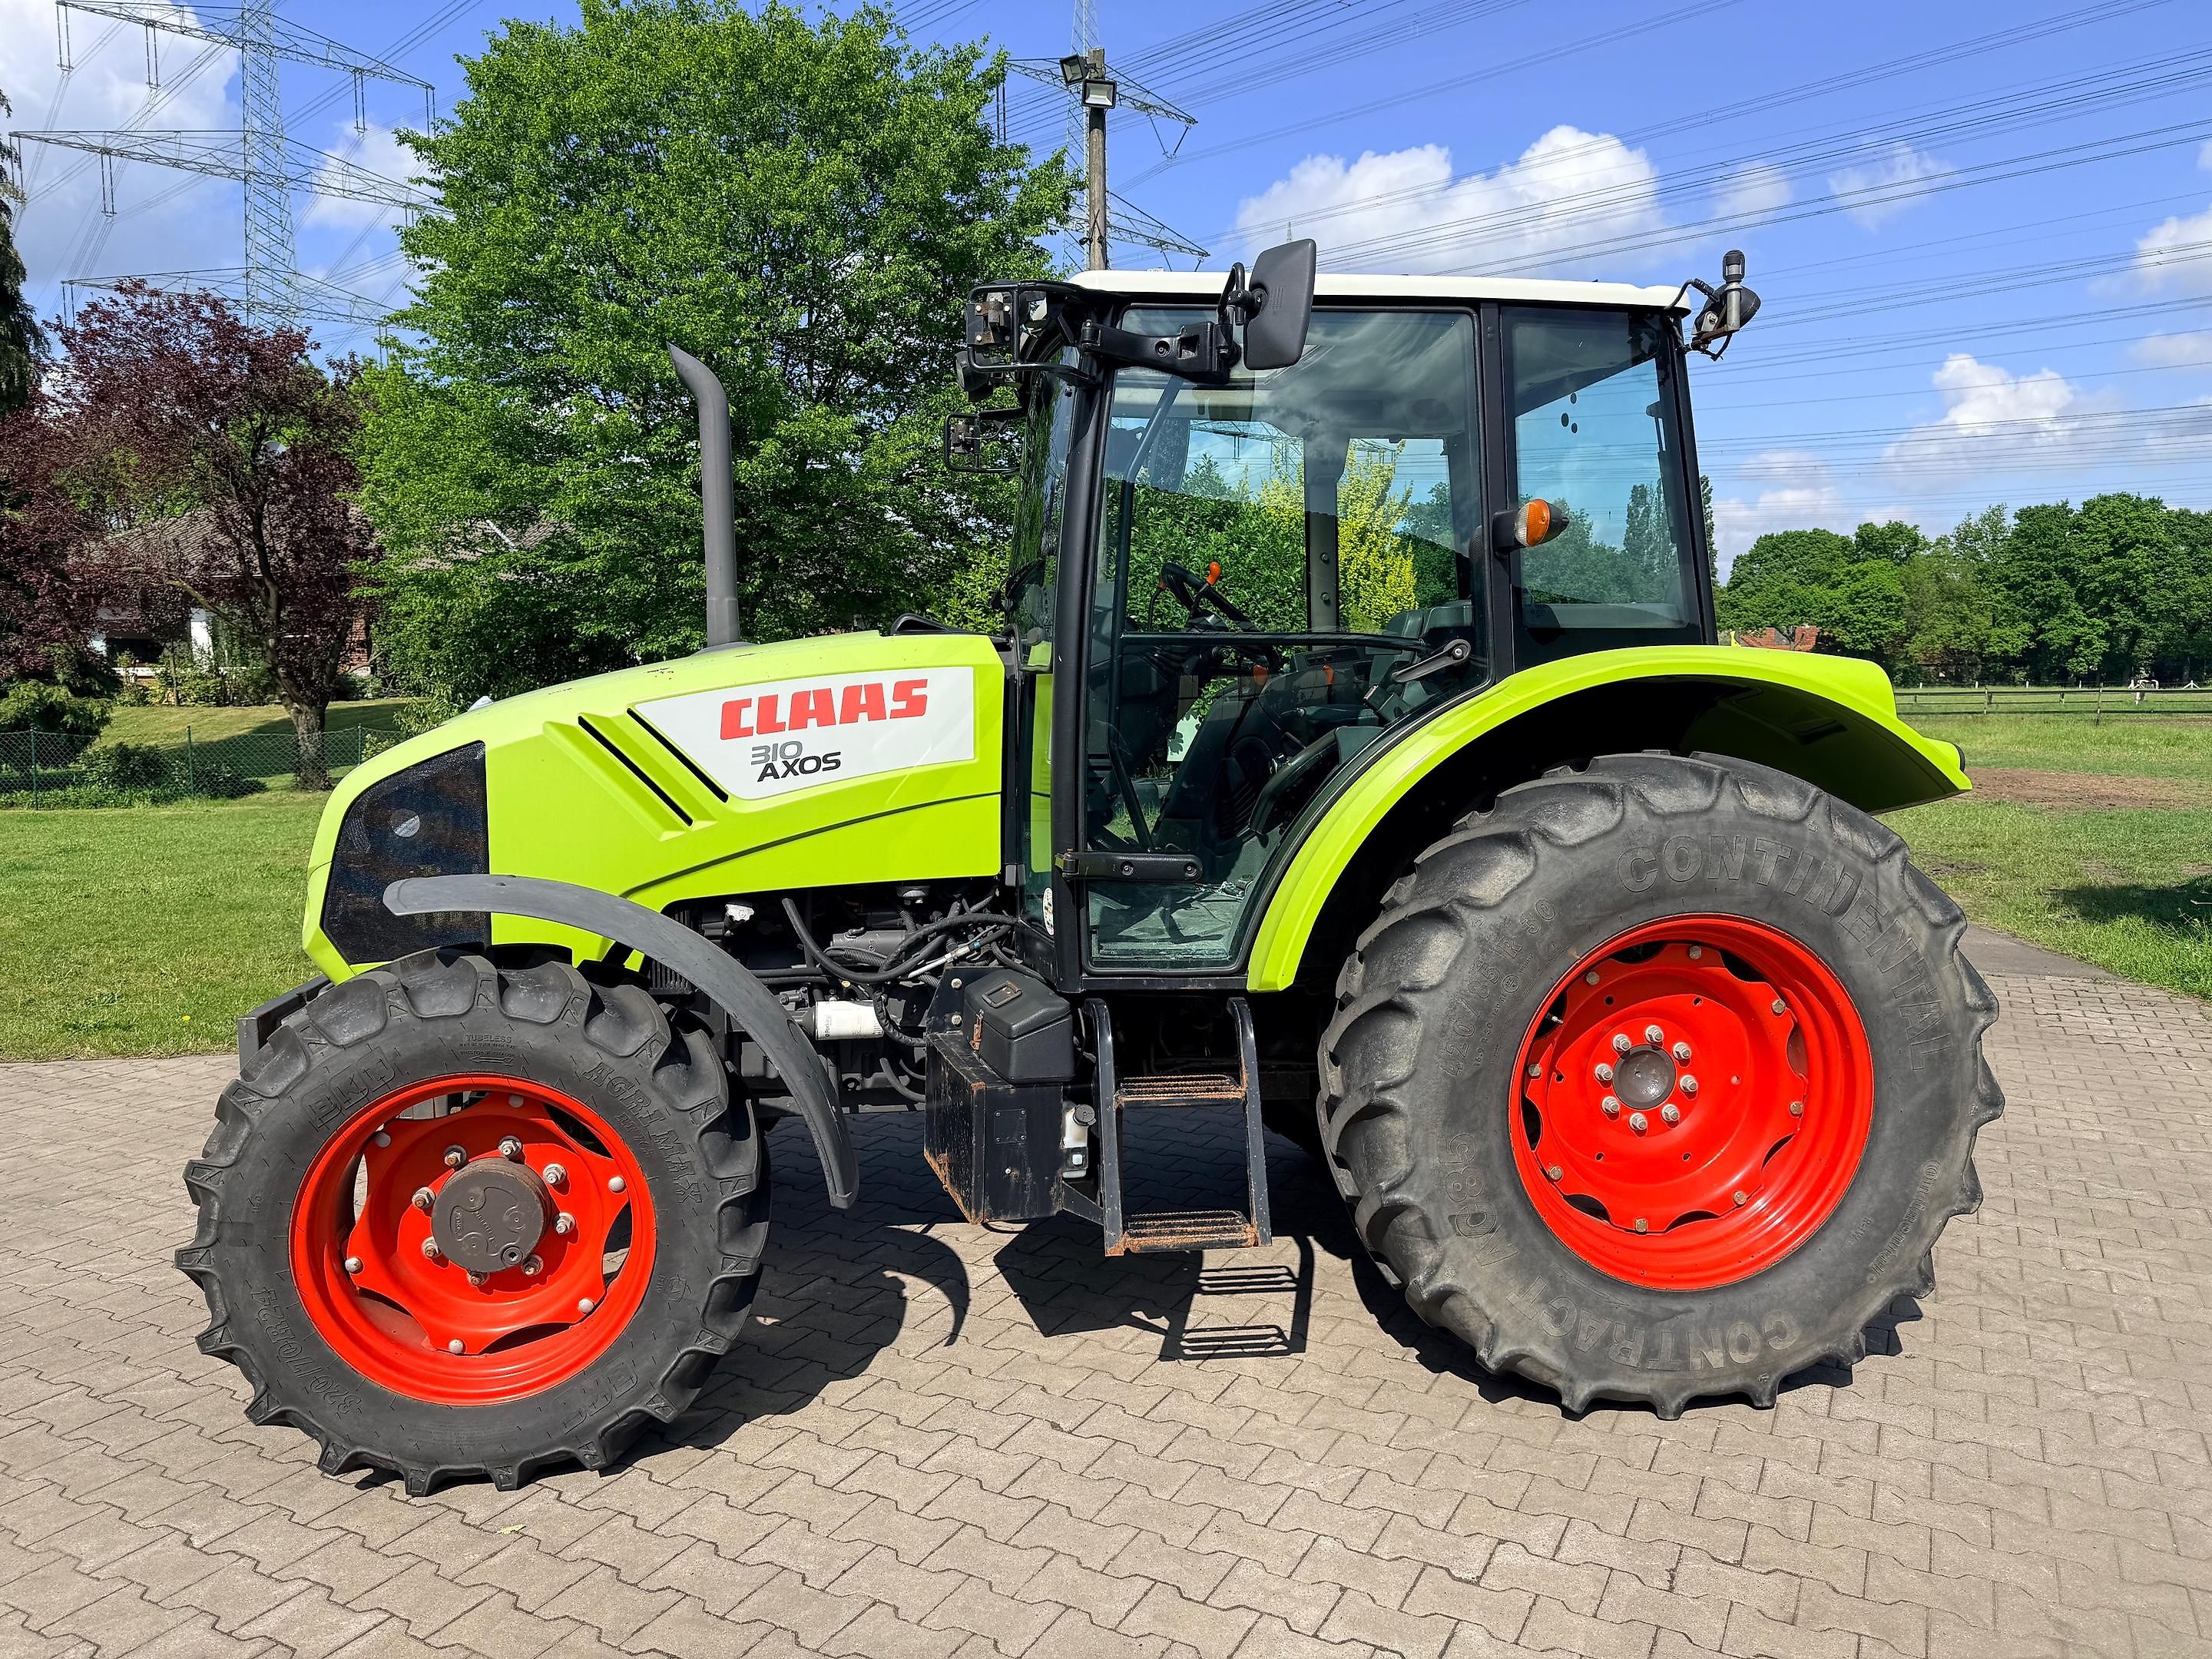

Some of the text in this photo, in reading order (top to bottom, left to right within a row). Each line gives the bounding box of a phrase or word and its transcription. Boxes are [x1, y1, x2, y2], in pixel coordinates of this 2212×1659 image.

[720, 679, 928, 740] CLAAS
[750, 740, 803, 766] 310
[757, 751, 842, 783] AXOS
[1618, 835, 1952, 1070] CONTINENTAL
[465, 1033, 513, 1044] TUBELESS
[1438, 1134, 1519, 1267] AC85
[251, 1286, 363, 1415] 320/70R24
[1506, 1276, 1799, 1372] CONTRACT
